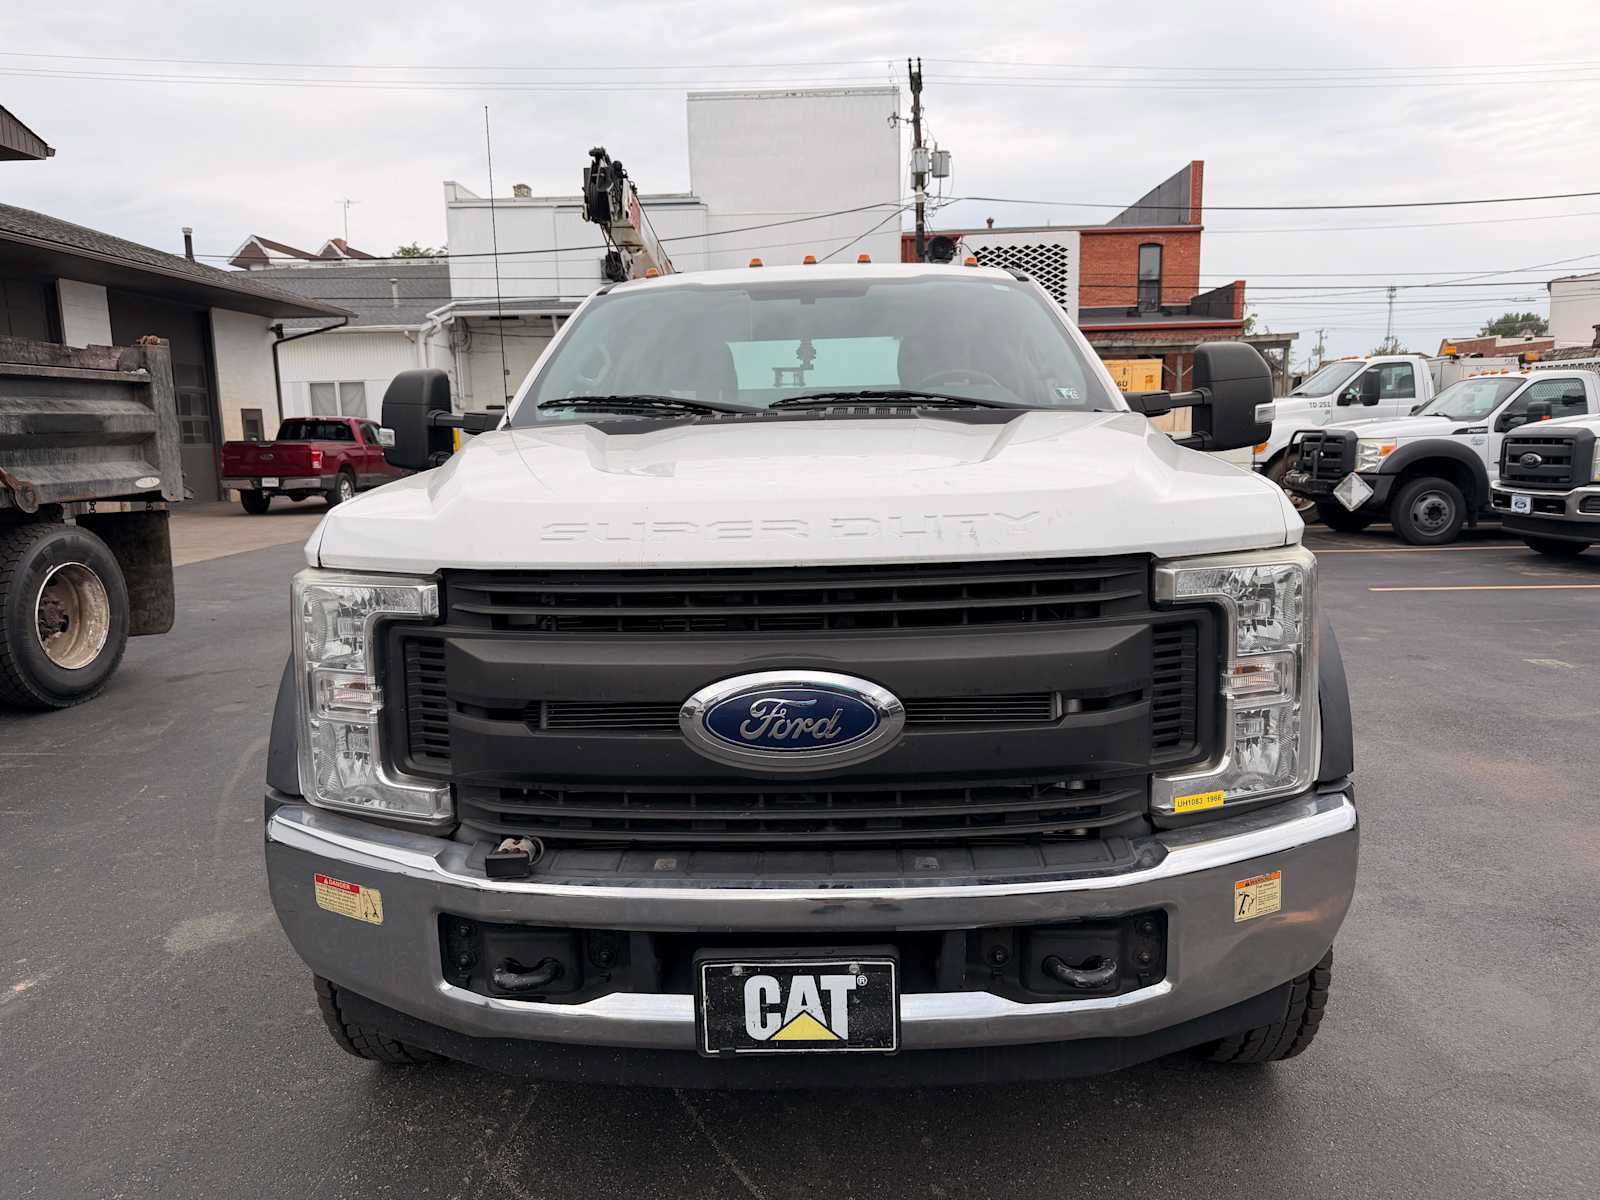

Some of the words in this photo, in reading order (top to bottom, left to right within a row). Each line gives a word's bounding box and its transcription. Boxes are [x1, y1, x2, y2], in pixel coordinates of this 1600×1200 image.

[540, 519, 809, 543] SUPER
[830, 509, 1041, 542] DUTY
[740, 697, 844, 740] Ford
